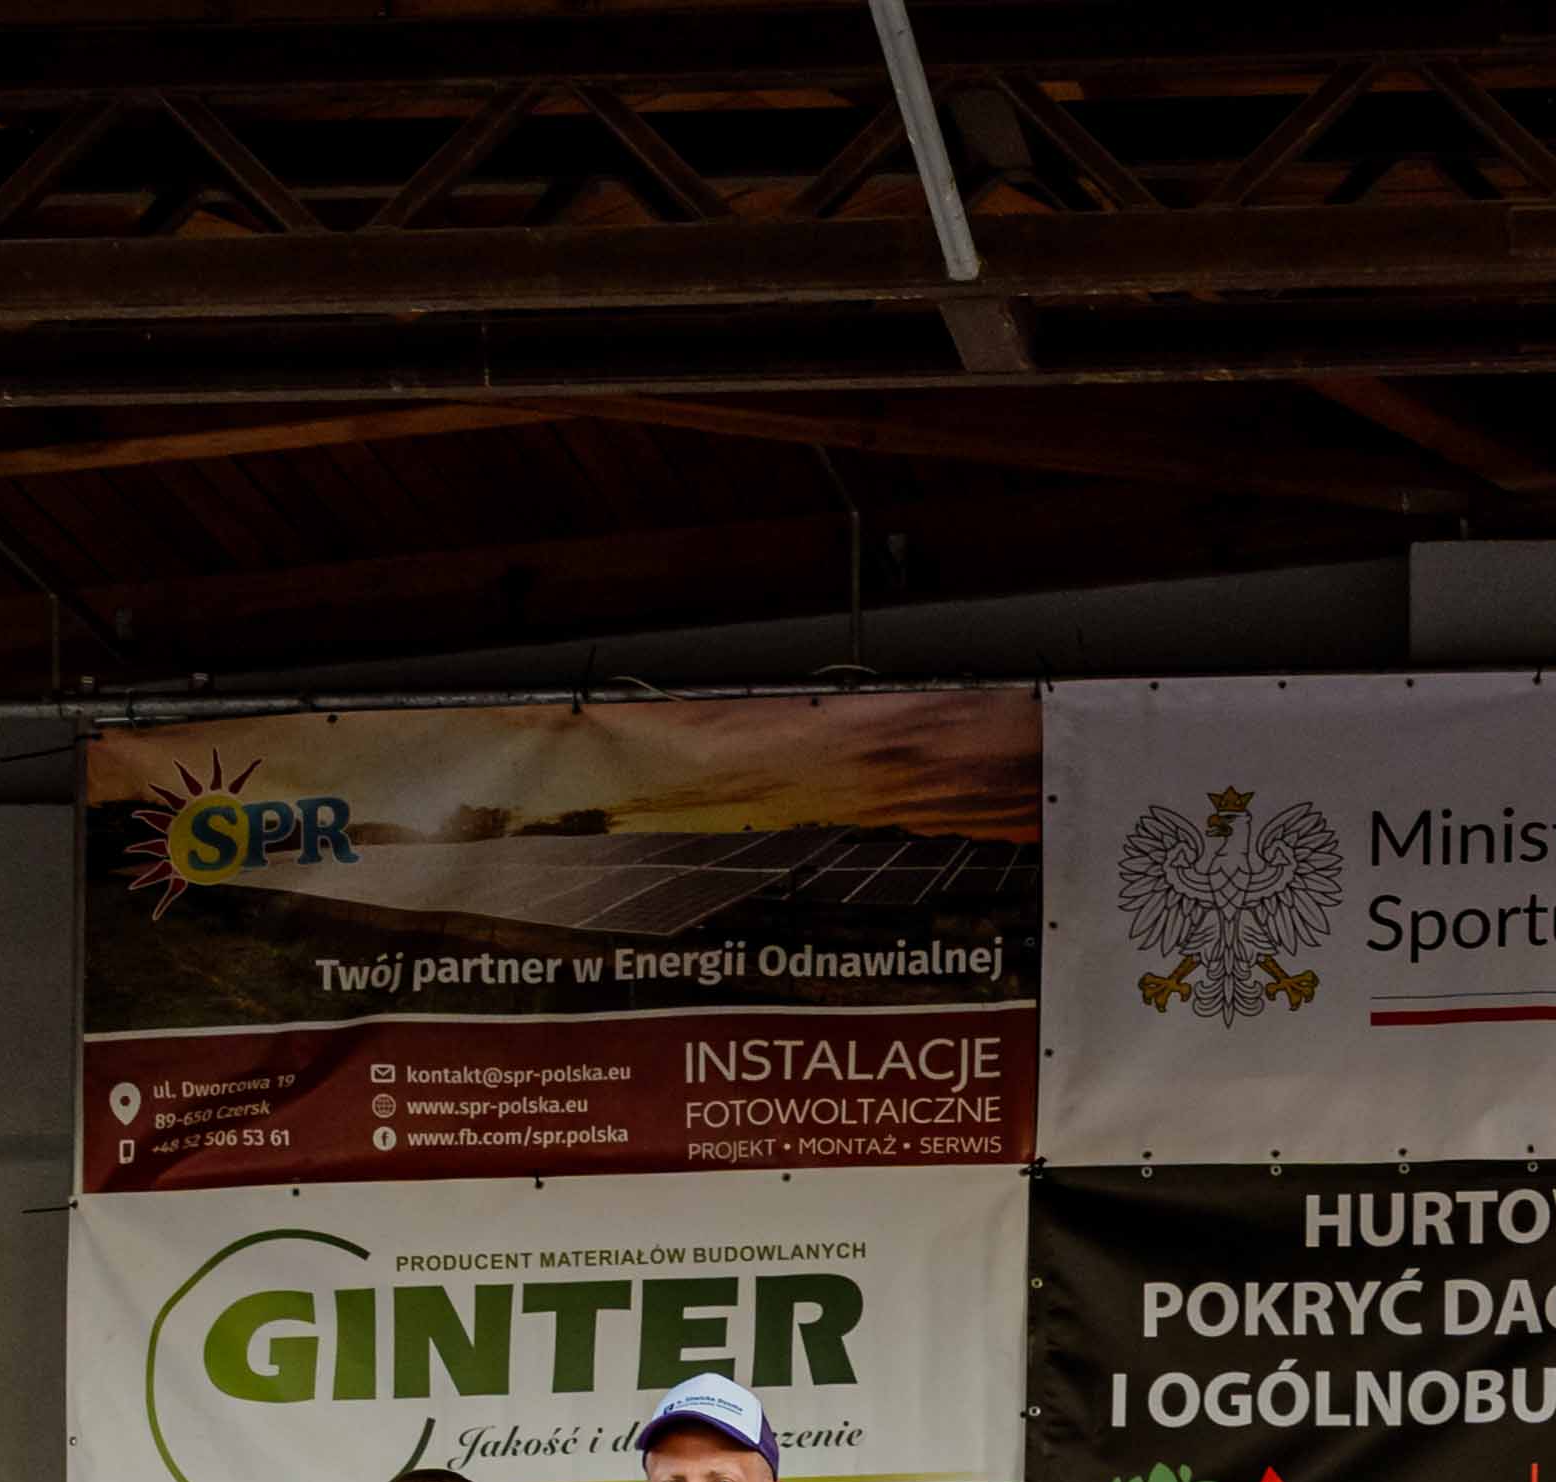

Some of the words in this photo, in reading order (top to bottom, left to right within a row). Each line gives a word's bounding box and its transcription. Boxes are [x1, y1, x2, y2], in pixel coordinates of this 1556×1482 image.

[185, 795, 359, 874] SPR
[315, 955, 404, 996] Twój
[413, 953, 562, 992] partner
[573, 957, 604, 984] w
[613, 942, 747, 987] Energii
[758, 935, 1005, 982] Odnawialnej
[405, 1062, 633, 1090] kontakt@spr-polska.eu
[684, 1036, 1003, 1094] INSTALACJE
[152, 1080, 176, 1099] ul.
[181, 1076, 272, 1099] Dworcowa
[276, 1072, 297, 1090] 19
[153, 1106, 212, 1130] 89-650
[215, 1098, 272, 1121] Czersk
[406, 1094, 589, 1121] www.spr-polska.eu
[684, 1096, 1003, 1129] FOTOWOLTAICZNE
[202, 1127, 238, 1149] 506
[241, 1127, 266, 1148] 53
[268, 1127, 292, 1147] 61
[407, 1123, 630, 1150] www.fb.com/spr.polska
[687, 1137, 777, 1166] PROJEKT
[798, 1133, 898, 1156] MONTAŻ
[919, 1135, 1003, 1156] SERWIS
[395, 1250, 533, 1273] PRODUCENT
[538, 1243, 687, 1270] MATERIAŁÓW
[692, 1241, 867, 1266] BUDOWLANYCH
[1141, 1267, 1425, 1339] POKRYĆ
[202, 1271, 865, 1404] GINTER
[1111, 1374, 1128, 1428] I
[446, 1420, 580, 1472] Jakość
[589, 1426, 604, 1455] i
